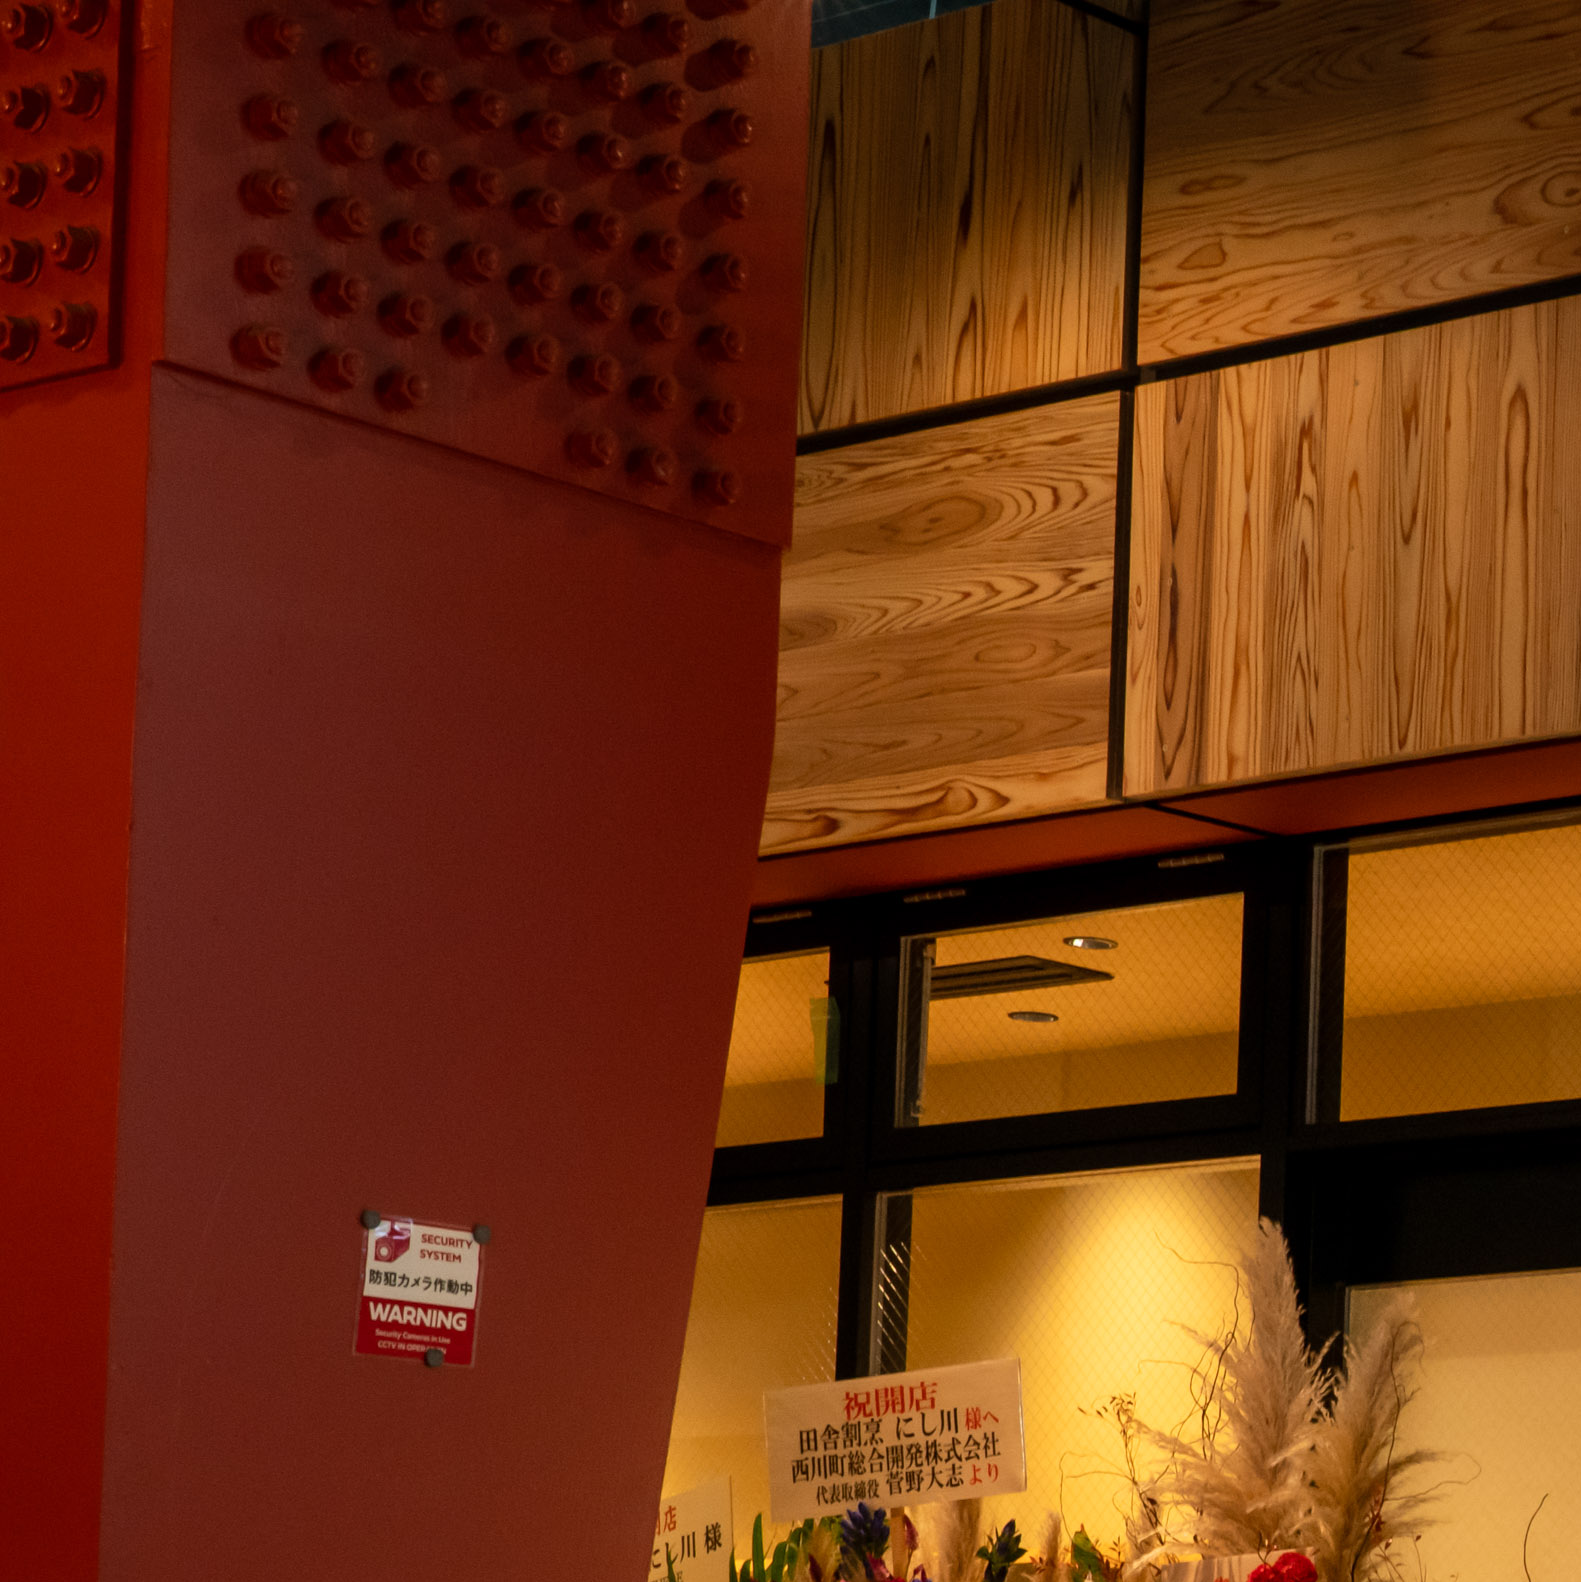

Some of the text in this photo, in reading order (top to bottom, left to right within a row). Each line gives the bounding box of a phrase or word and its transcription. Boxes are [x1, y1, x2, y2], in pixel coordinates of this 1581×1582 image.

[421, 1233, 473, 1249] SECURITY
[420, 1249, 462, 1263] SYSTEM
[369, 1269, 473, 1296] 防犯カメラ作動中
[369, 1301, 467, 1331] WARNING
[375, 1328, 402, 1340] Security
[377, 1339, 396, 1349] CCTV
[842, 1381, 938, 1421] 祝開店
[791, 1431, 1001, 1484] 西川町総合開発株式会社
